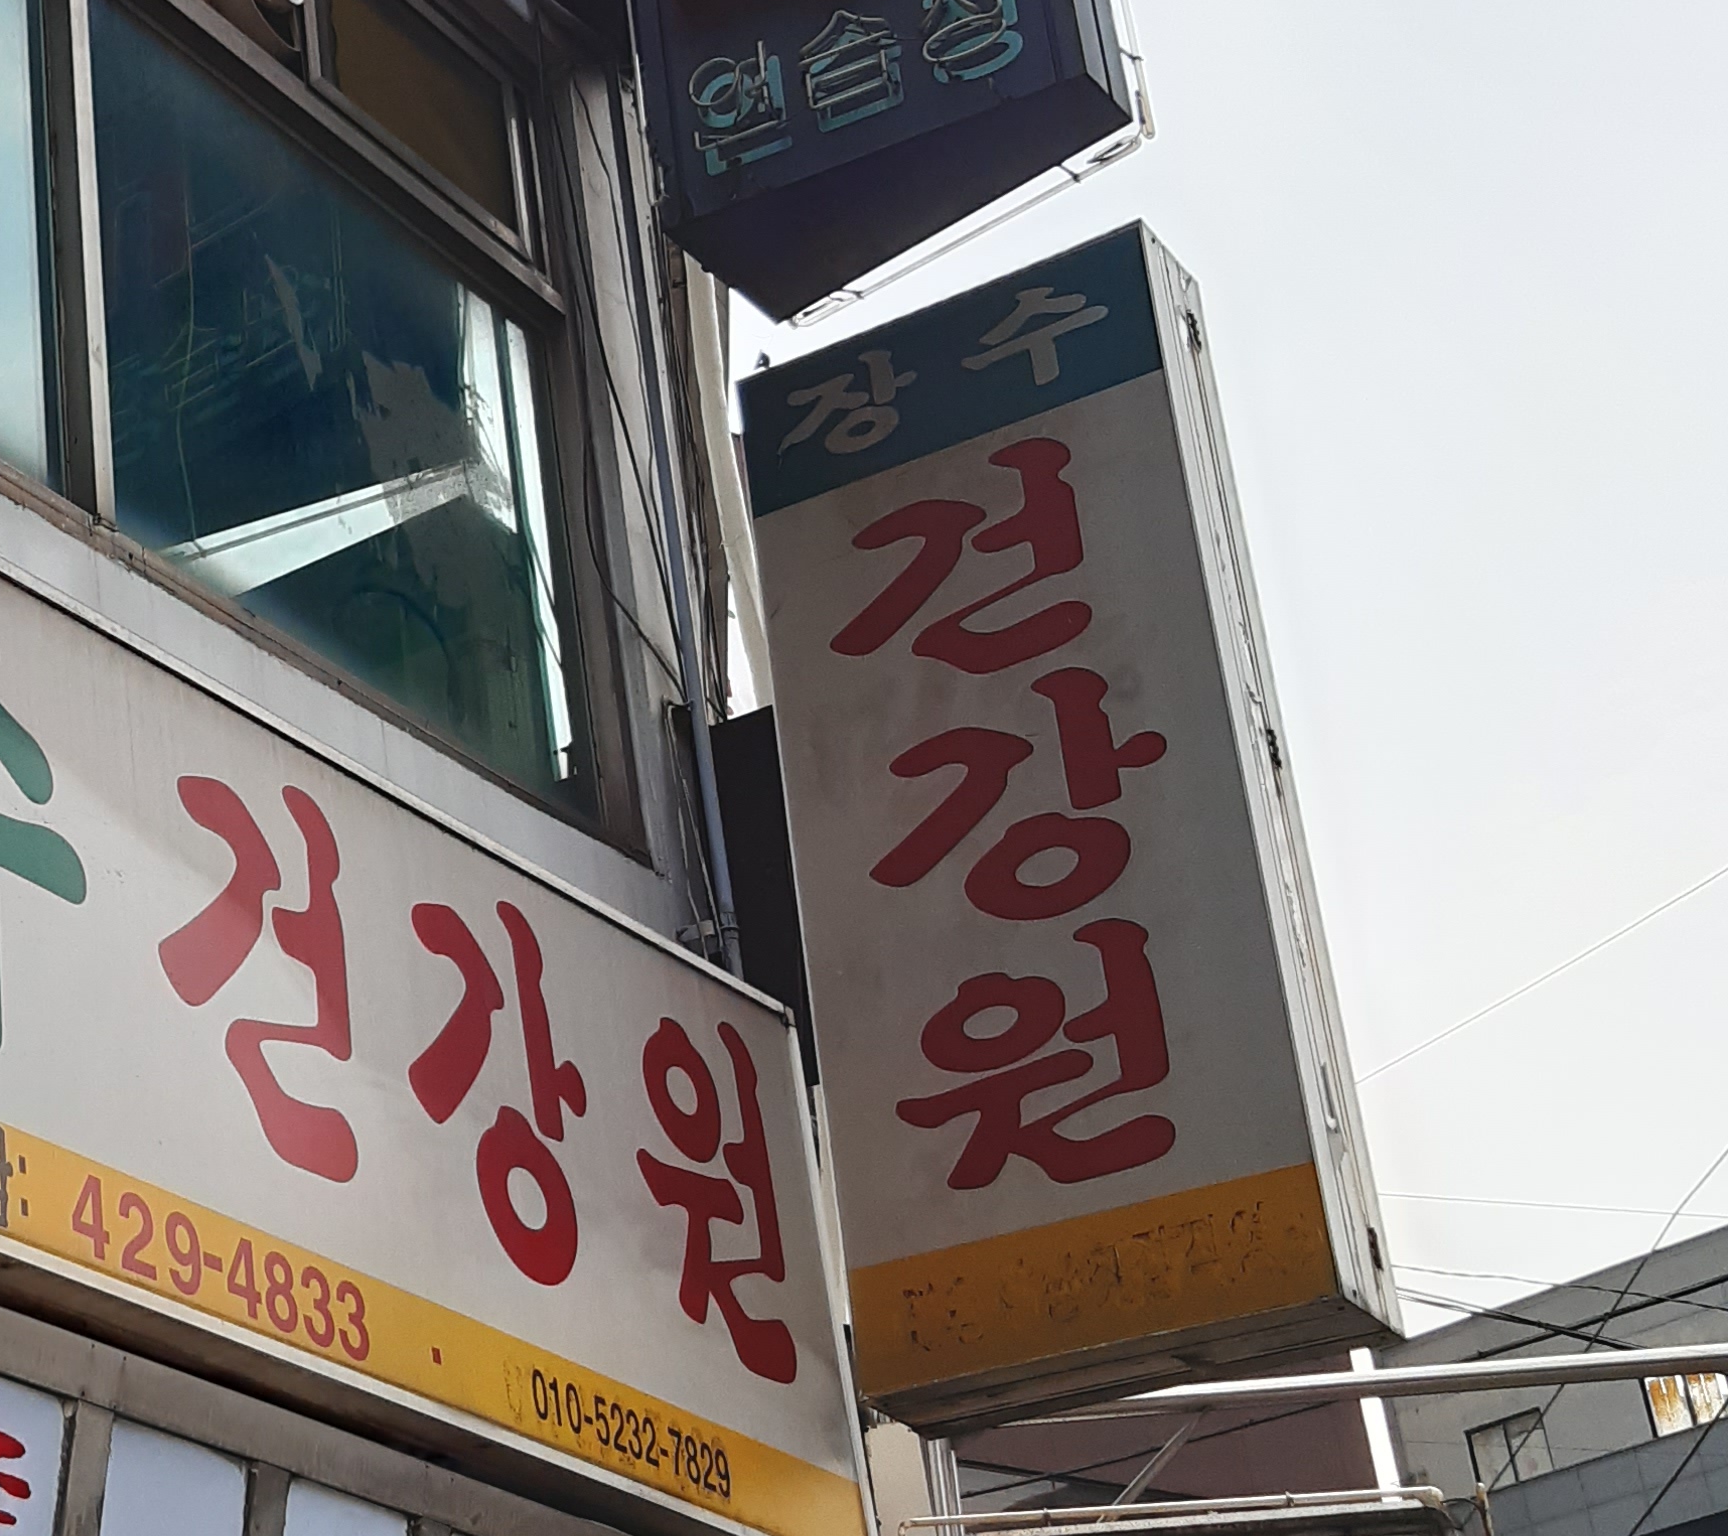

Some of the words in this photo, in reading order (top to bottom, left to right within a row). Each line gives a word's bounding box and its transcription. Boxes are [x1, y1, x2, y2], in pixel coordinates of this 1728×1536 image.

[778, 286, 1108, 456] 장수
[829, 436, 1177, 1190] 건강원
[72, 1172, 371, 1363] 429-4833
[530, 1367, 733, 1501] 010-5232-7829
